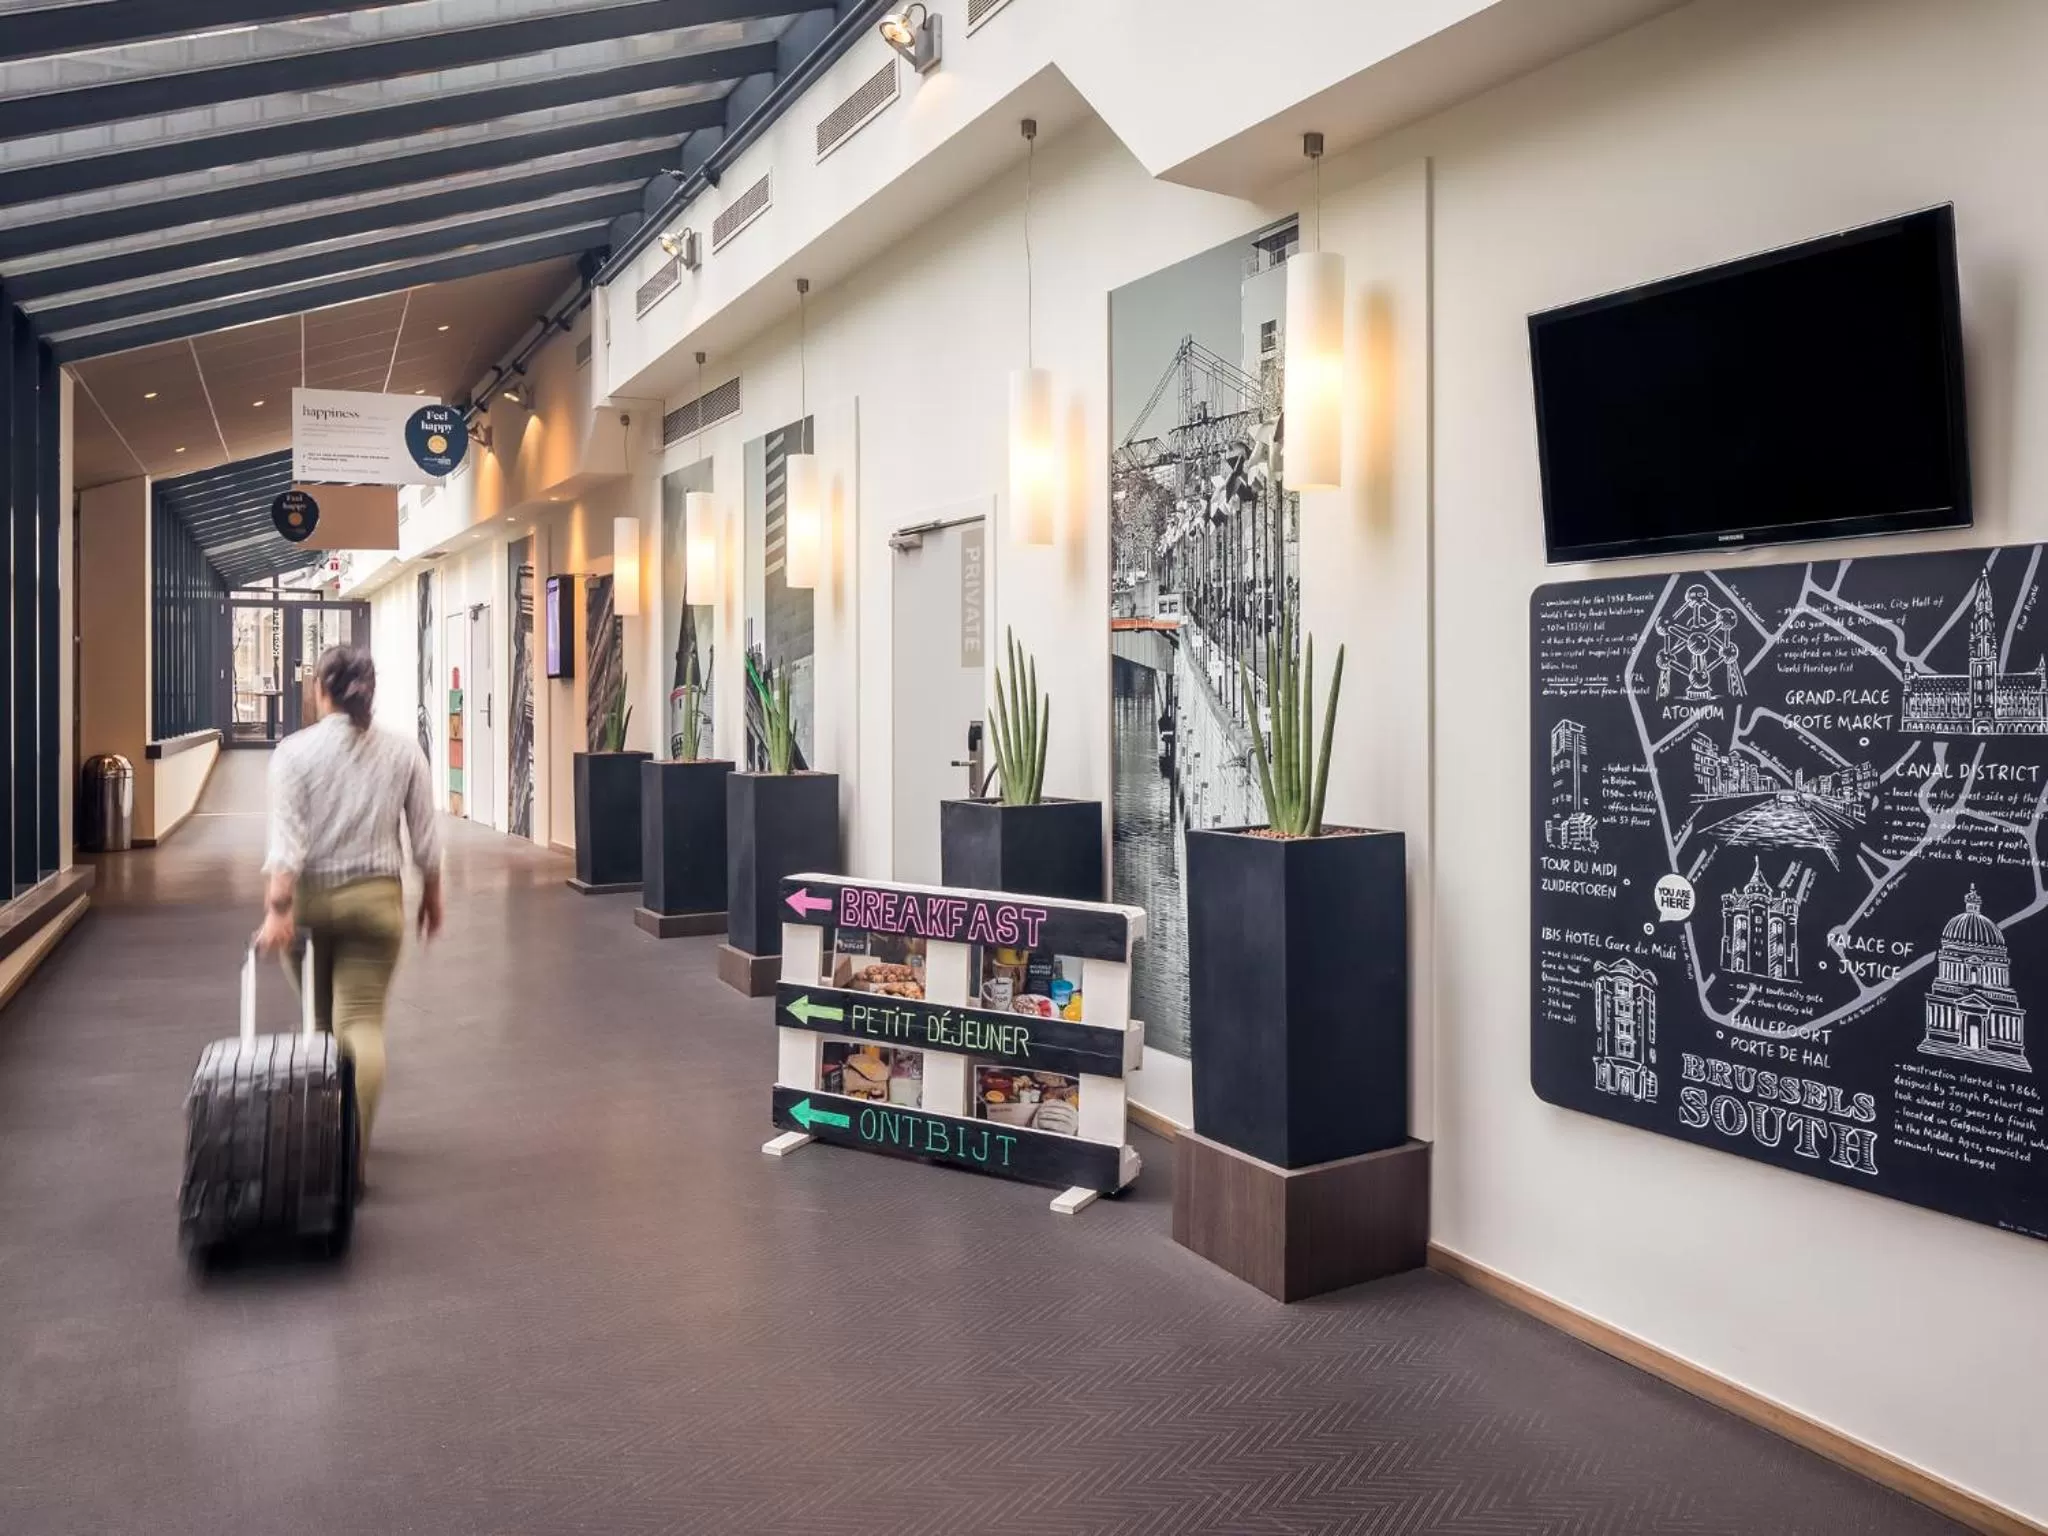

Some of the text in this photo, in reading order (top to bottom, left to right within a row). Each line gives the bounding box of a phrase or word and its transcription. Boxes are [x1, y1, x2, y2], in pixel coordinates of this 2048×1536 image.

[302, 405, 360, 420] happiness
[427, 411, 448, 420] Feel
[421, 420, 452, 434] happy
[965, 545, 980, 653] PRIVATE
[1891, 598, 1909, 610] City
[1912, 596, 1930, 607] Hall
[1933, 594, 1944, 608] of
[1896, 614, 1906, 626] of
[1792, 634, 1809, 645] City
[1811, 633, 1821, 645] of
[1785, 689, 1890, 705] GRAND-PLACE
[1662, 705, 1724, 720] ATOMIUM
[1783, 714, 1893, 731] GROTE MARKT
[1896, 762, 2040, 783] CANAL DISTRICT
[1893, 787, 1923, 798] located
[1940, 789, 1955, 799] the
[2007, 792, 2018, 804] of
[2023, 792, 2039, 803] the
[1998, 839, 2028, 850] people
[1540, 857, 1617, 877] TOUR DU MIDI
[1929, 849, 1952, 859] relax
[1955, 849, 1963, 860] &
[1968, 853, 1993, 865] enjoy
[1541, 879, 1616, 897] ZUIDERTOREN
[1658, 887, 1691, 898] YOU ARE
[1661, 897, 1690, 910] HERE
[840, 888, 1047, 947] BREAKFAST
[1542, 927, 1676, 960] IBIS HOTEL Gare du Midi
[1827, 933, 1914, 957] PALACE OF
[1839, 959, 1901, 980] JUSTICE
[1730, 1014, 1832, 1046] HALLEPOORT
[1731, 1037, 1831, 1069] PORTE DE HAL
[1681, 1053, 1877, 1122] BRUSSELS
[1902, 1064, 1956, 1081] construction
[1960, 1073, 1993, 1088] started
[1996, 1079, 2006, 1091] in
[1894, 1074, 1932, 1091] designed
[1934, 1082, 1945, 1096] by
[1949, 1086, 1980, 1102] Joseph
[2026, 1106, 2044, 1116] and
[1894, 1089, 2037, 1132] took almost 20 years to finish
[1902, 1106, 1934, 1123] located
[1936, 1118, 1948, 1126] on
[859, 1108, 1017, 1165] ONTBIJT
[1679, 1086, 1879, 1175] SOUTH
[1894, 1119, 1903, 1132] in
[1906, 1123, 1920, 1135] the
[1923, 1127, 1954, 1143] Middle
[1986, 1145, 2031, 1162] convicted
[1894, 1137, 1996, 1170] criminals were hanged
